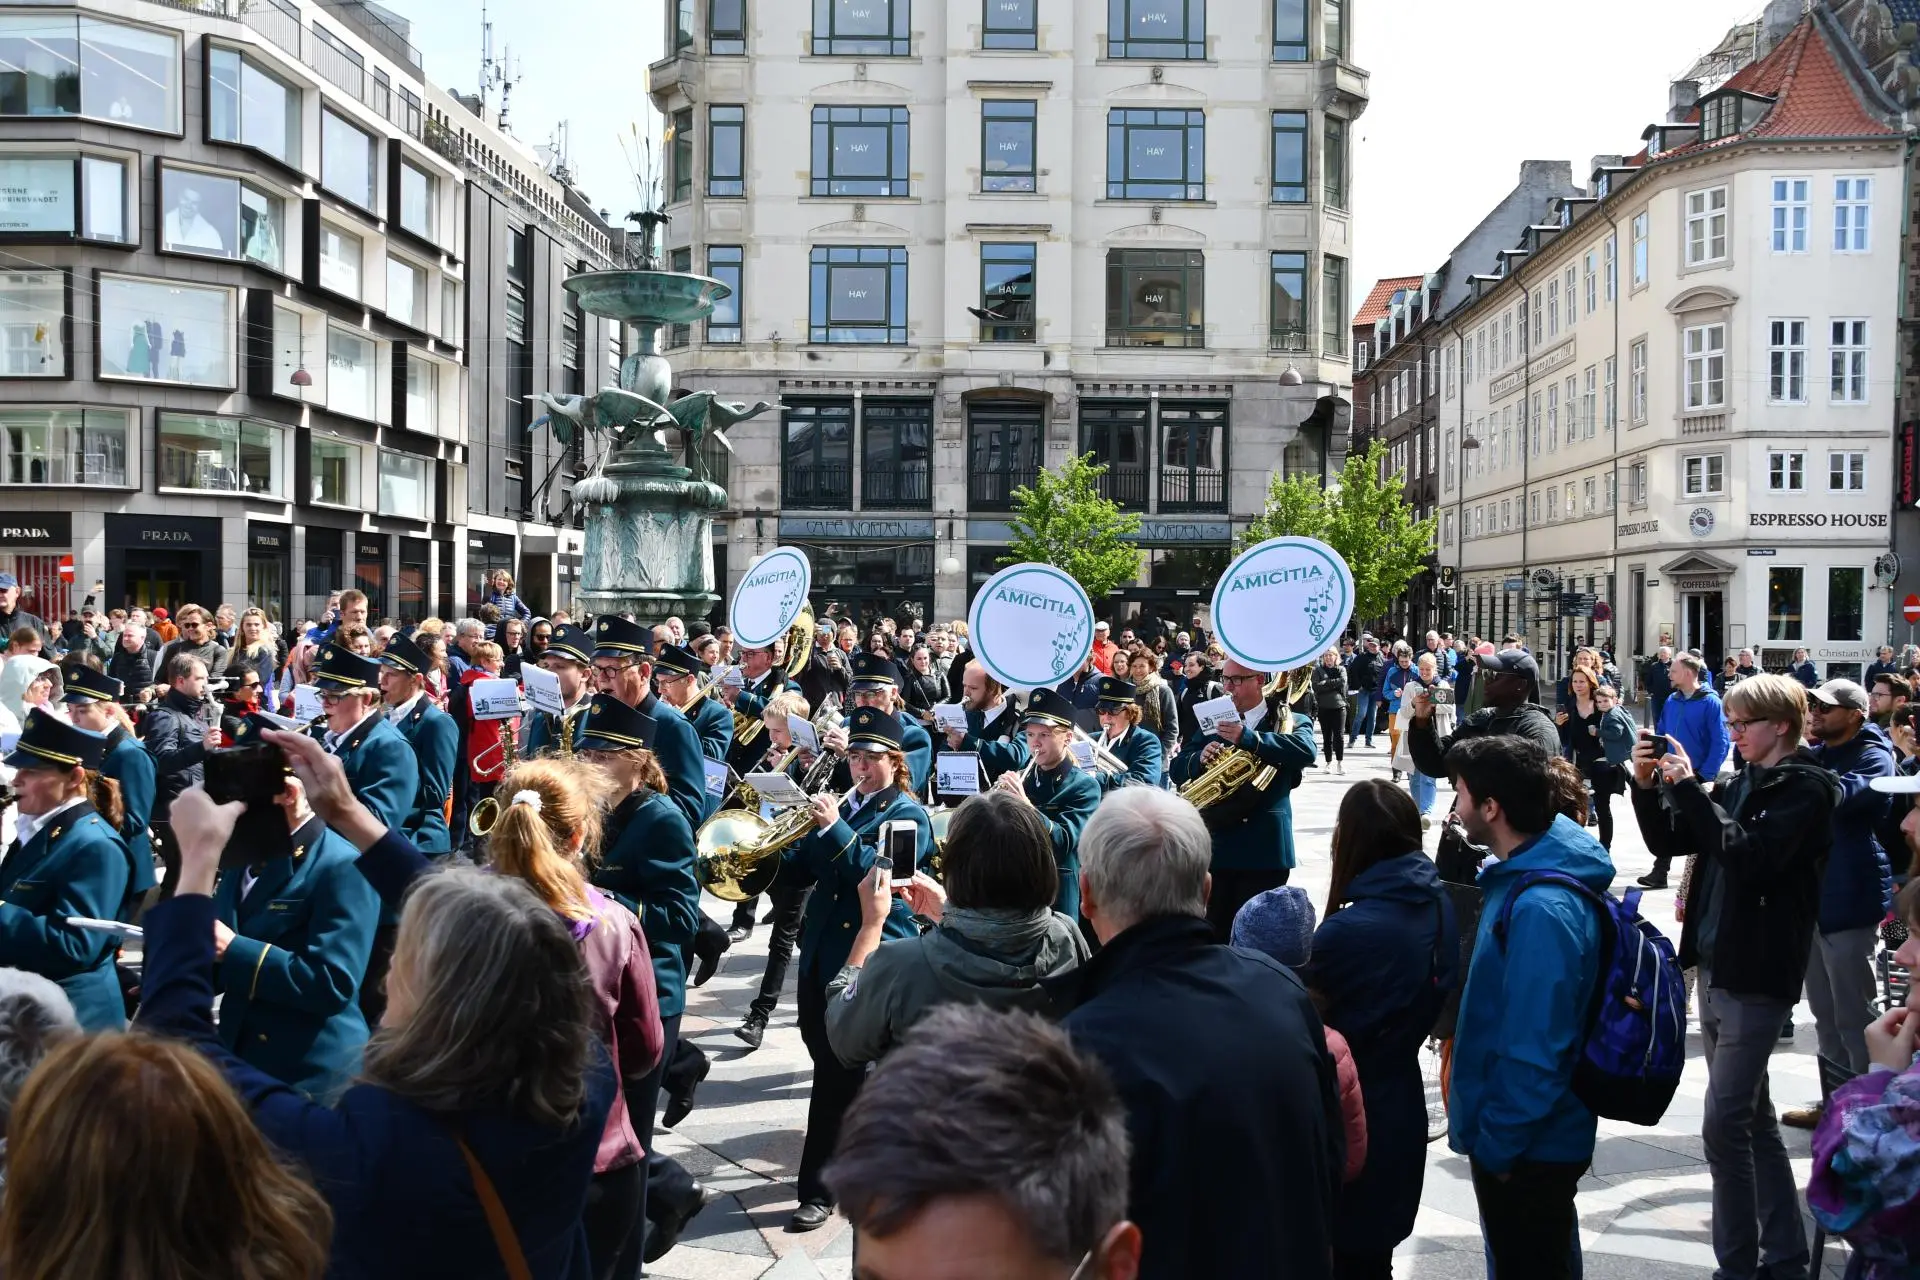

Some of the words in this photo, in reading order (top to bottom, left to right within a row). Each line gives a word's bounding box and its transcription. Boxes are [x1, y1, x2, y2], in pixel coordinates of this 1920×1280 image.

[1000, 3, 1019, 11] HAY
[852, 10, 870, 18] HAY
[1147, 13, 1166, 21] HAY
[850, 144, 869, 152] HAY
[999, 142, 1018, 151] HAY
[1146, 147, 1165, 156] HAY
[848, 290, 867, 298] HAY
[998, 285, 1018, 294] HAY
[1145, 295, 1164, 303] HAY
[1749, 513, 1827, 527] ESPRESSO
[1831, 514, 1888, 527] HOUSE
[2, 527, 51, 538] PRADA
[850, 521, 908, 537] NORDEN
[1146, 524, 1203, 540] NORDEN
[1618, 522, 1641, 536] ESPRESSO
[1641, 520, 1659, 534] HOUSE
[142, 530, 192, 542] PRADA
[746, 569, 797, 589] AMICITIA
[1230, 565, 1323, 593] AMICITIA
[1682, 580, 1721, 589] COFFEEBAR
[995, 589, 1077, 616] AMICITIA
[1818, 648, 1859, 658] Christian
[1862, 648, 1873, 658] IV
